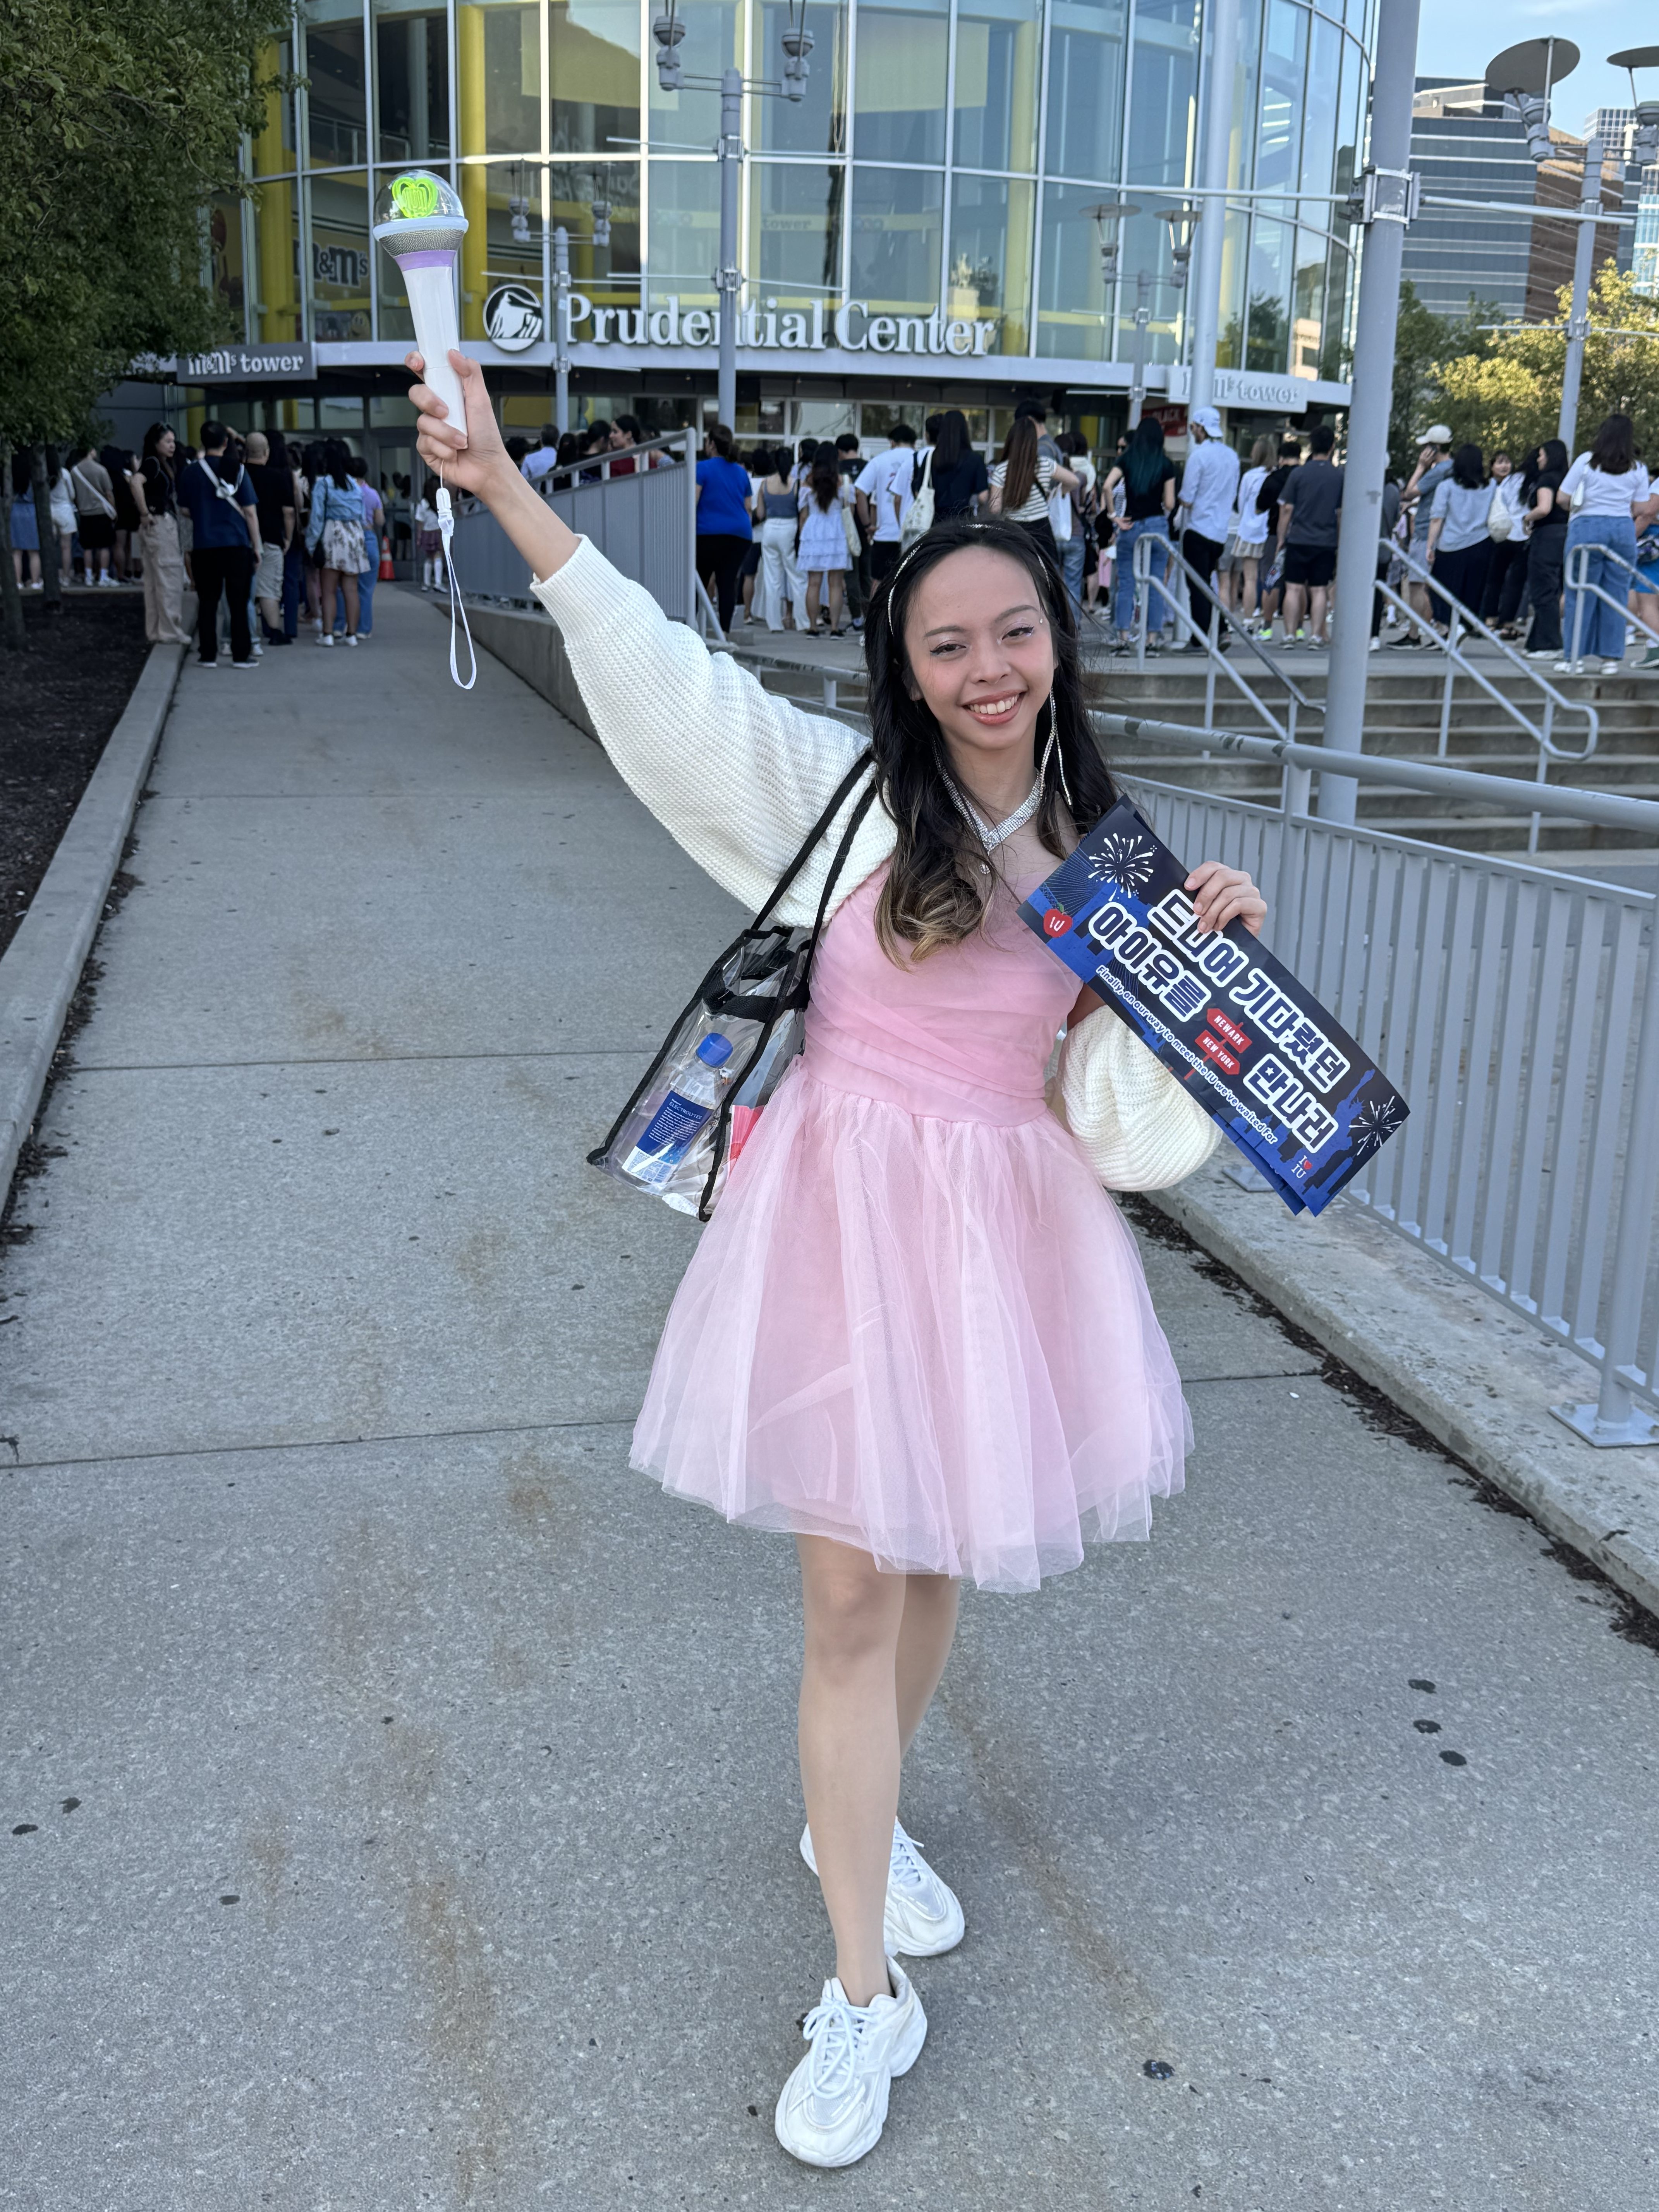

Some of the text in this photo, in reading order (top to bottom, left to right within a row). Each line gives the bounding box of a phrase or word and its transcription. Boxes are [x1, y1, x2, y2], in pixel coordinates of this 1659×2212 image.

[567, 293, 994, 356] Prudential Center
[240, 353, 304, 373] tower
[1237, 380, 1298, 404] tower
[1049, 916, 1065, 932] IU
[1149, 891, 1348, 1092] 드디어 기다렸던
[1090, 903, 1336, 1151] 아이유를 만나러
[1214, 1015, 1245, 1046] NEWARK
[1202, 1036, 1235, 1069] NEW YORK
[1123, 992, 1135, 1004] on
[1133, 1001, 1151, 1017] our
[1147, 1014, 1166, 1033] way
[1163, 1029, 1175, 1042] to
[1172, 1040, 1195, 1062] meet
[1192, 1058, 1207, 1075] the
[1205, 1071, 1218, 1084] IU
[1214, 1081, 1238, 1106] we've
[1237, 1103, 1266, 1131] waited
[1262, 1128, 1277, 1144] for
[669, 1101, 702, 1120] ELECTROLYTES
[1291, 1164, 1306, 1178] IU
[1298, 1155, 1307, 1164] I
